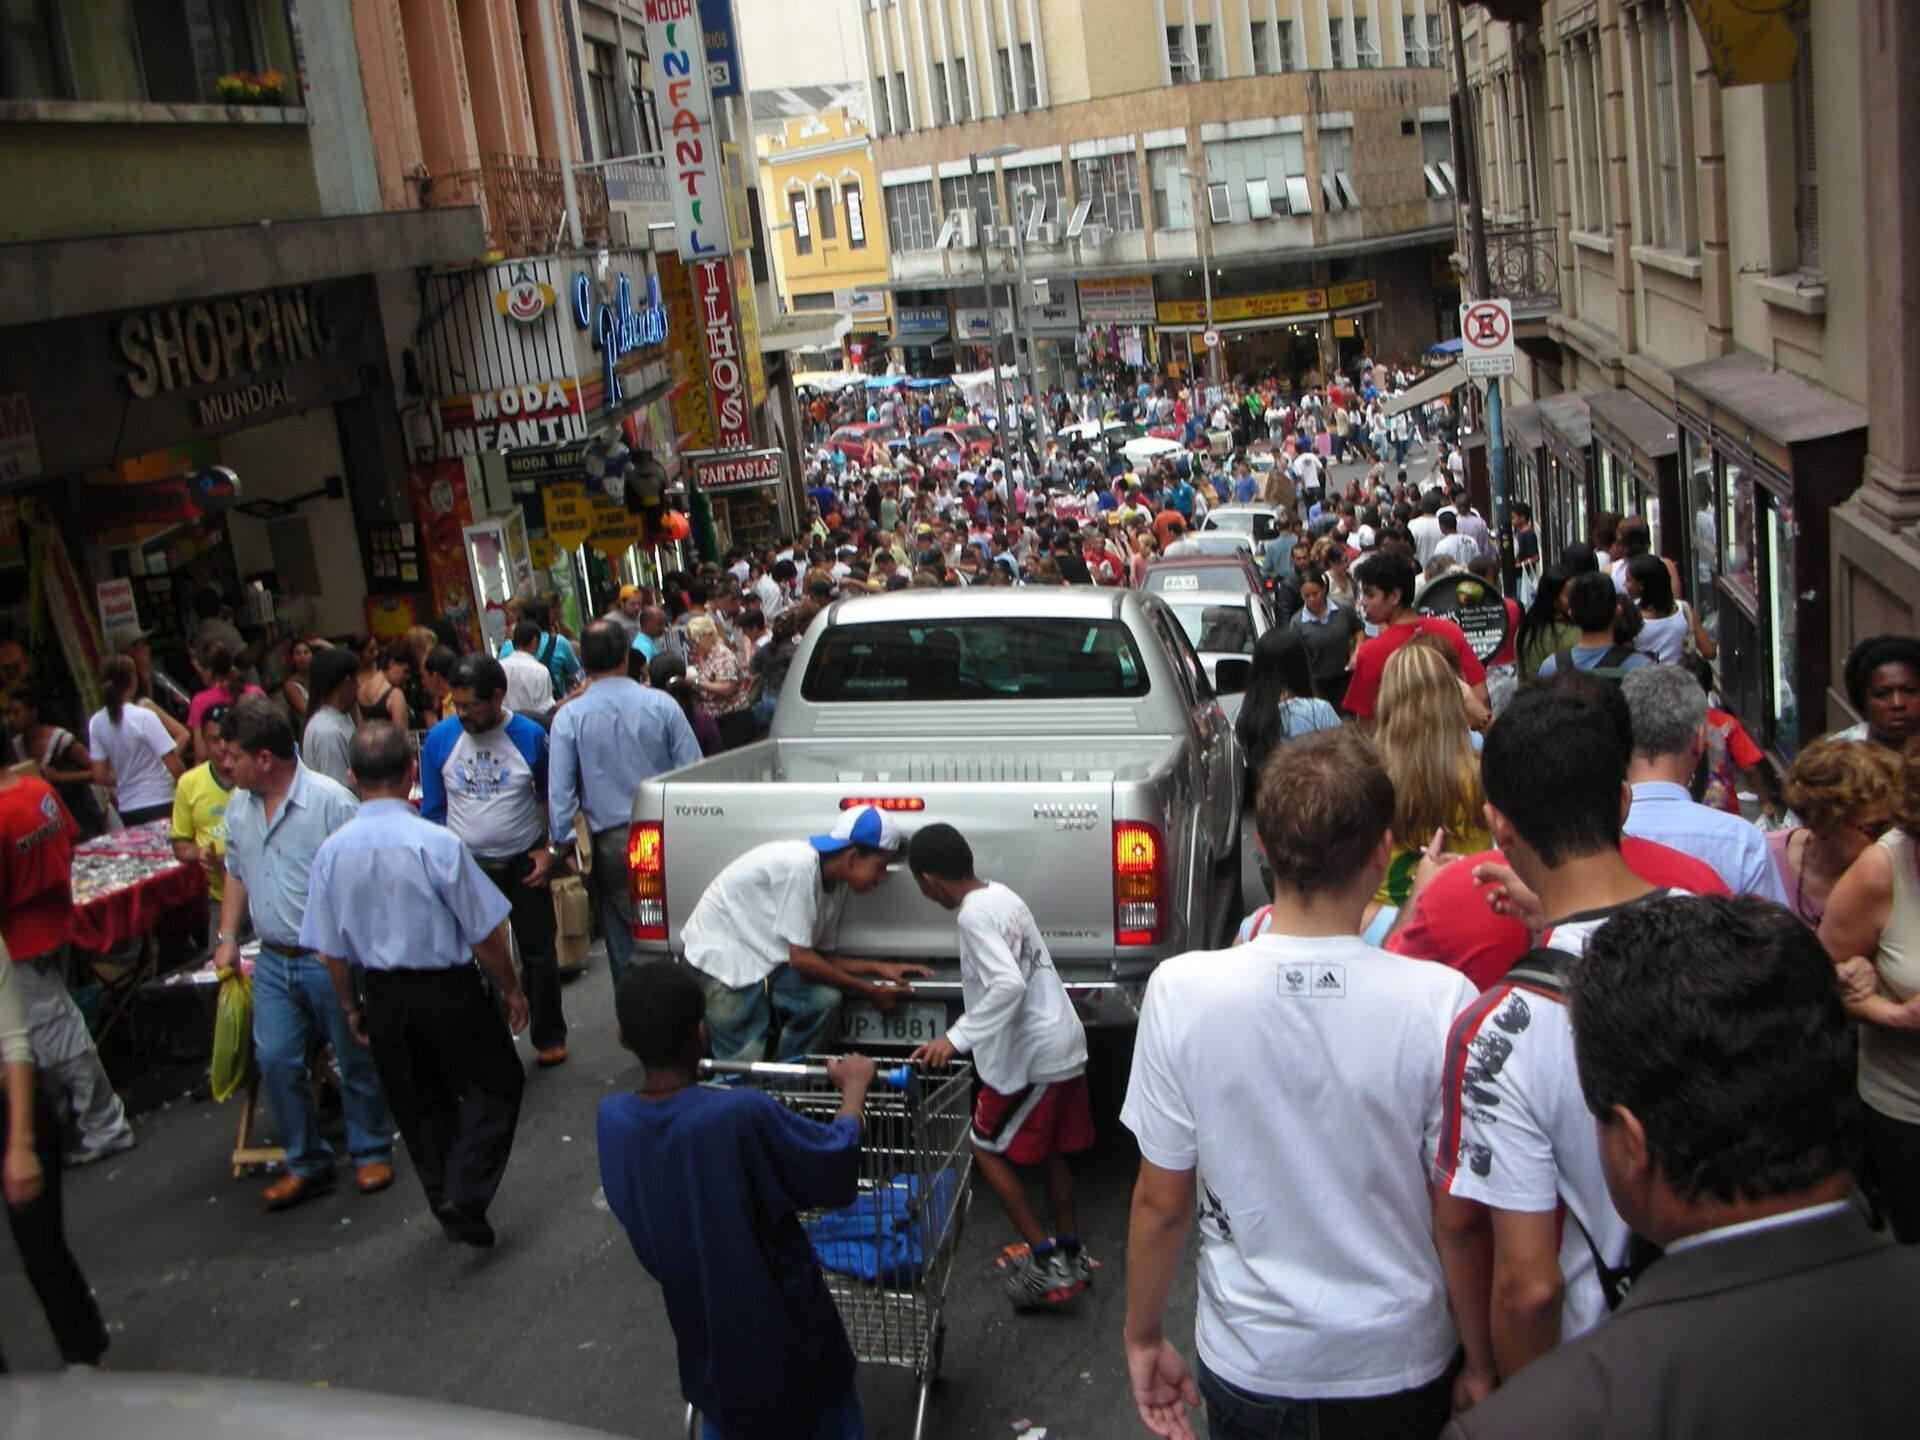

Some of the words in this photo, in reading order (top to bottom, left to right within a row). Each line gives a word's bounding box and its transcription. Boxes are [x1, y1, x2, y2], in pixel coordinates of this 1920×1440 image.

[644, 0, 692, 24] MODA
[708, 65, 727, 84] 3
[663, 23, 716, 254] INFANTIL
[118, 289, 337, 399] SHOPPING
[699, 257, 744, 431] ILHOS
[198, 379, 296, 426] MUNDIAL
[471, 384, 571, 421] MODA
[443, 410, 588, 456] INFANTIL
[511, 456, 548, 472] MODA
[698, 458, 781, 487] FANTASIAS
[674, 804, 725, 817] TOYOTA
[1033, 802, 1098, 818] HILUX
[1315, 981, 1340, 989] adidas
